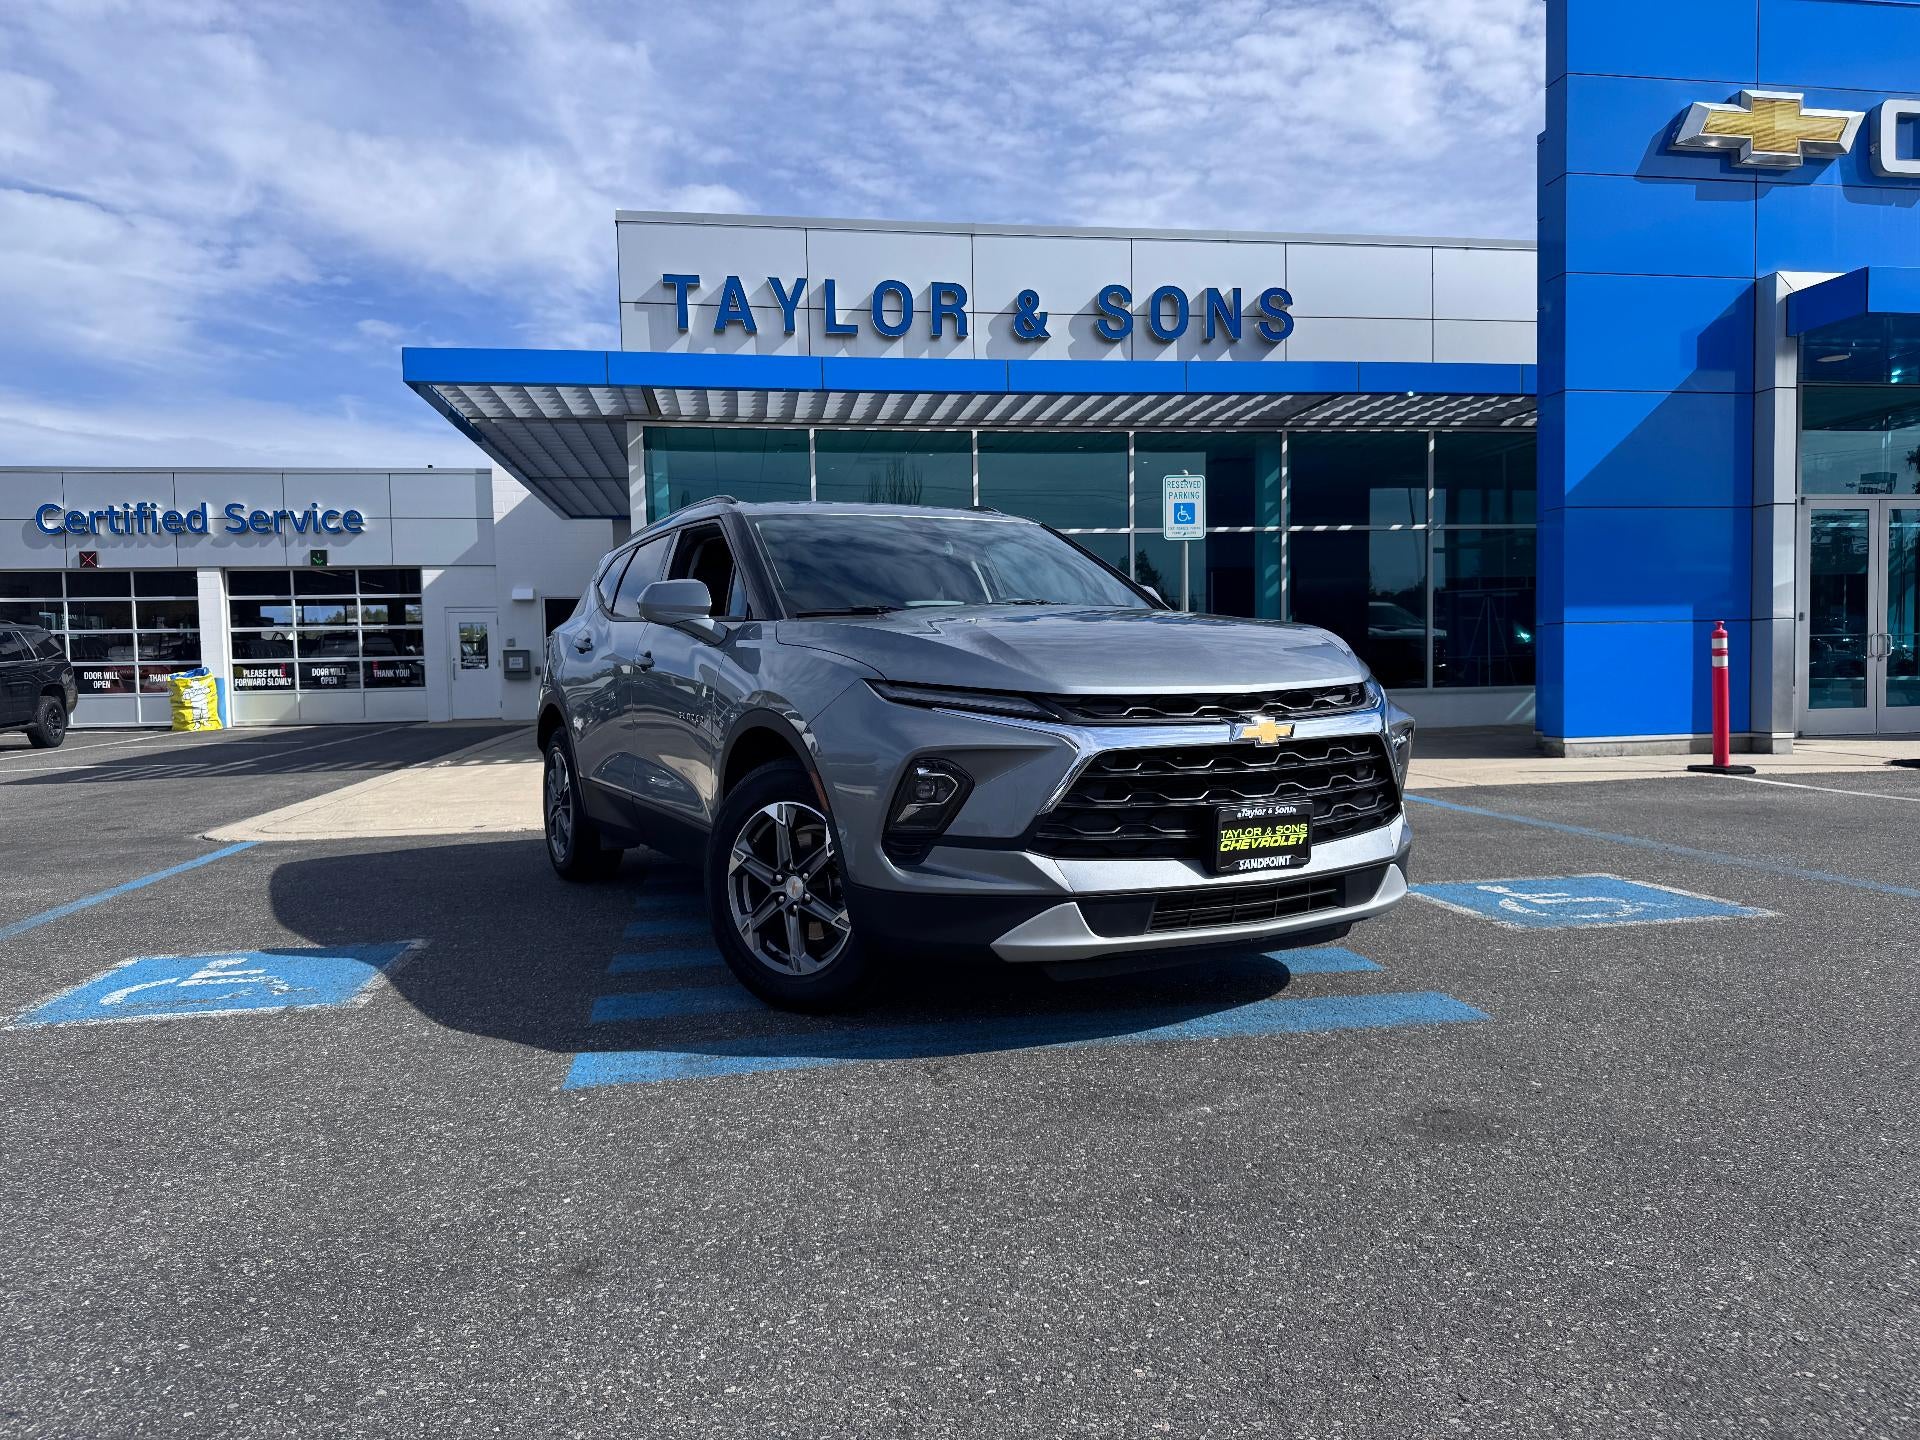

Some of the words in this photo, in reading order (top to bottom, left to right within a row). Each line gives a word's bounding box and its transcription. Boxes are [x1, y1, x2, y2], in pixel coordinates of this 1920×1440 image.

[661, 272, 970, 337] TAYLOR
[1012, 288, 1052, 340] &
[1097, 284, 1295, 342] SONS
[1167, 480, 1201, 489] RESERVED
[1168, 491, 1200, 500] PARKING
[35, 501, 209, 535] Certified
[224, 502, 366, 535] Service
[83, 671, 102, 680] DOOR
[103, 671, 120, 680] WILL
[243, 669, 267, 678] PLEASE
[267, 668, 284, 677] PULL
[311, 668, 329, 677] DOOR
[329, 667, 346, 676] WILL
[373, 669, 394, 678] THANK
[395, 668, 410, 677] YOU!
[93, 680, 111, 689] OPEN
[234, 677, 267, 687] FORWARD
[267, 677, 293, 686] SLOWLY
[320, 676, 338, 685] OPEN
[1241, 807, 1266, 818] Taylor
[1220, 827, 1262, 840] TAYLOR
[1265, 827, 1273, 836] &
[1275, 823, 1308, 835] SONS
[1220, 834, 1308, 852] CHEVROLET
[1239, 855, 1292, 870] SANDPOINT
